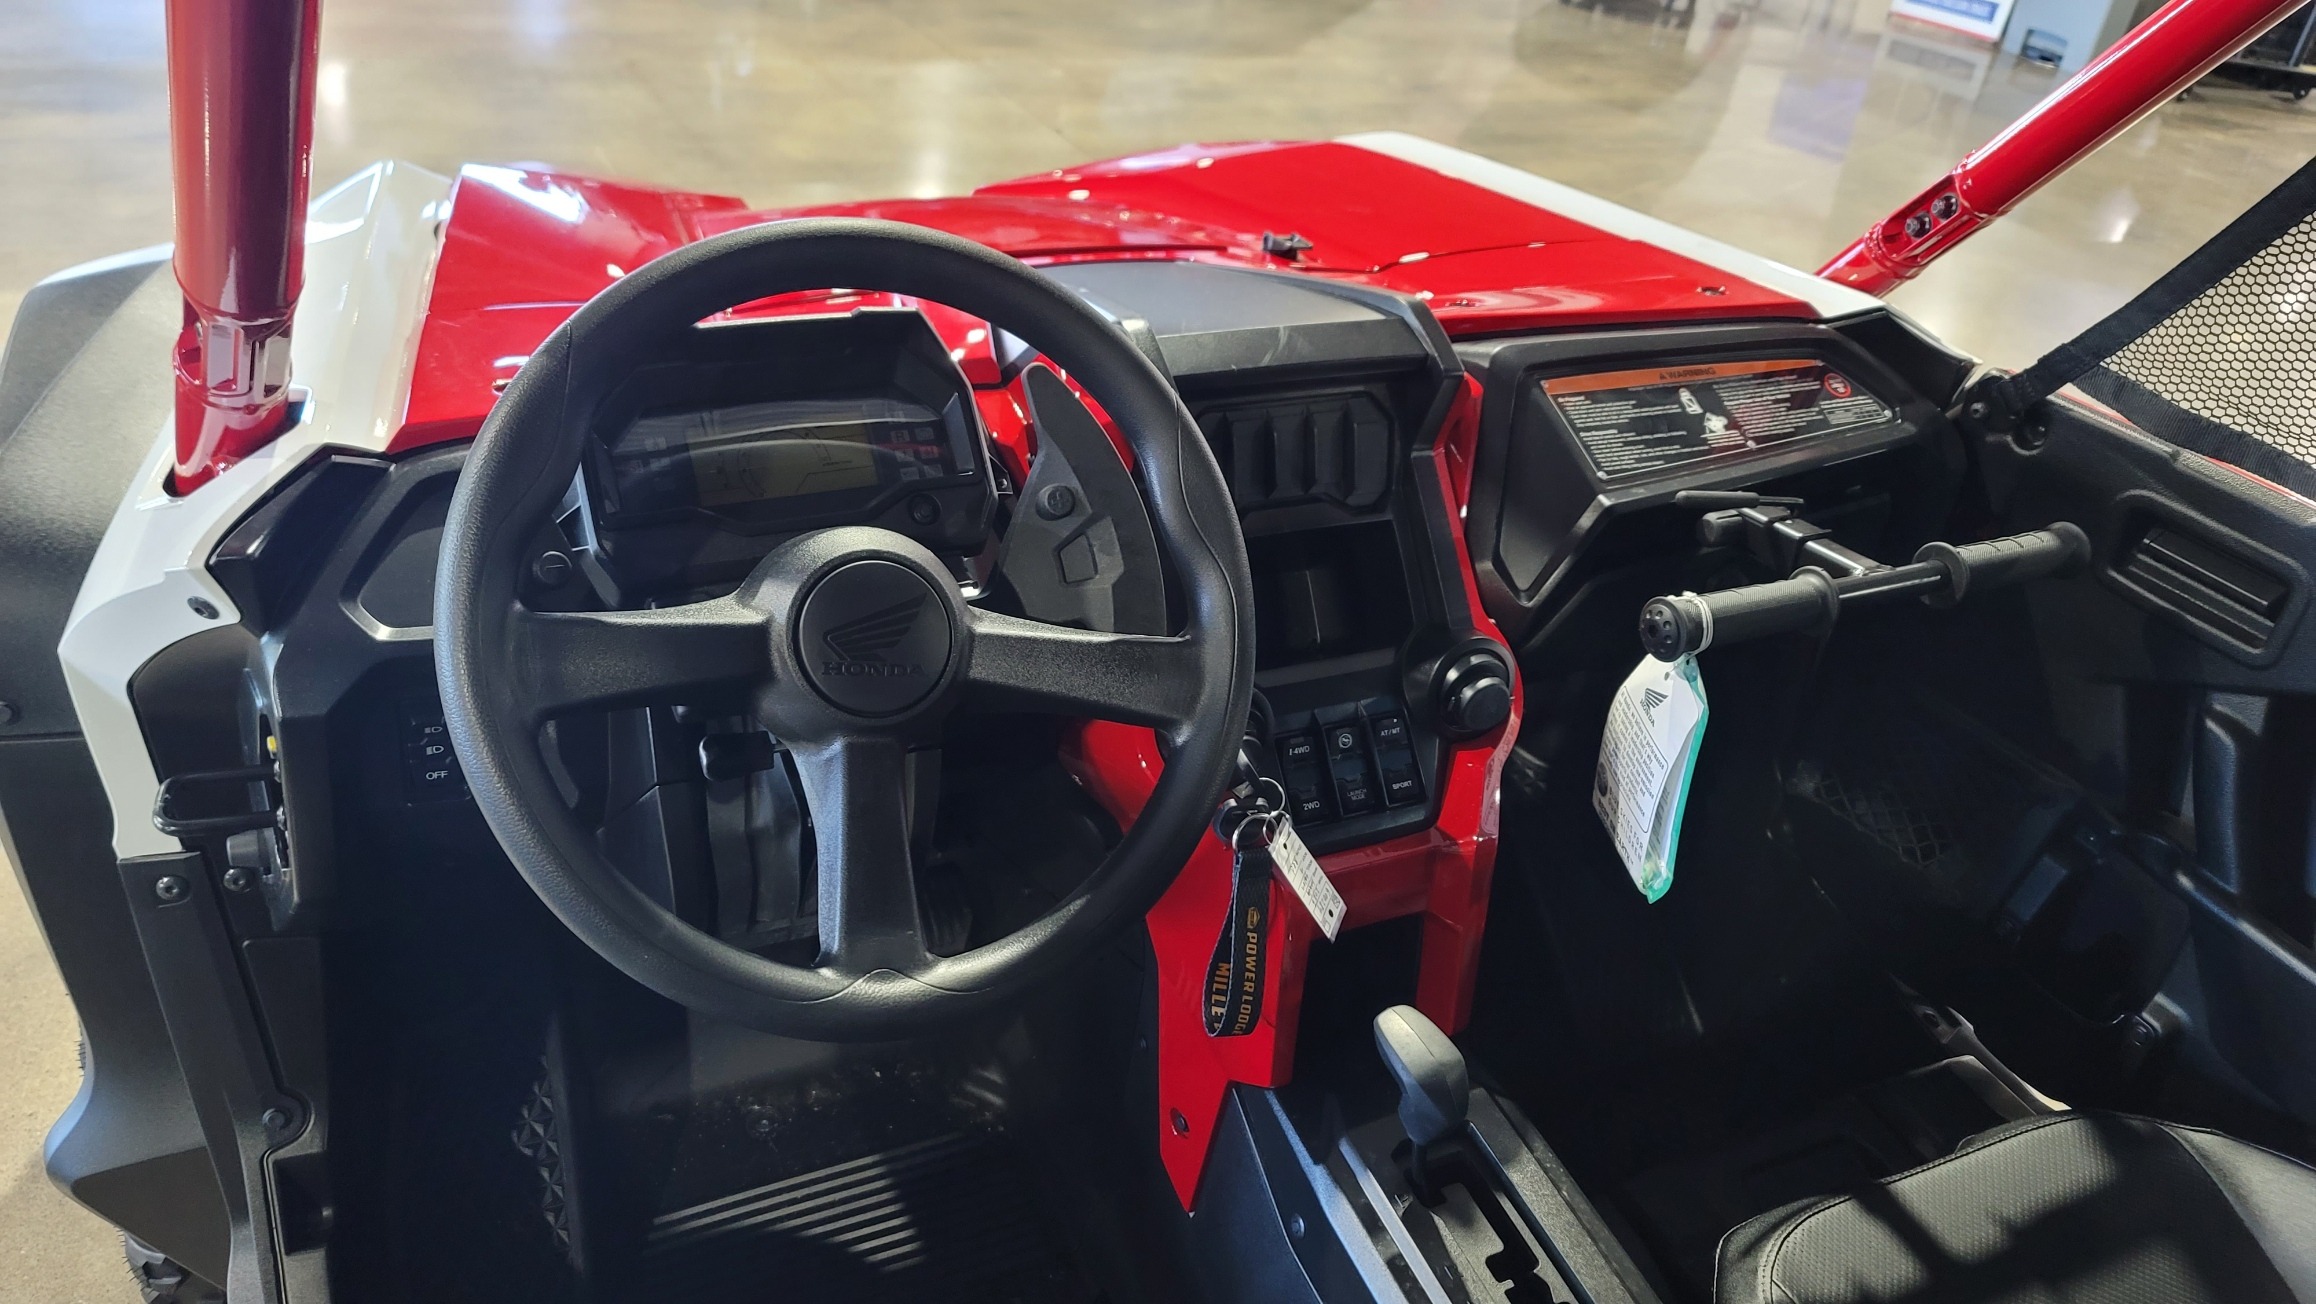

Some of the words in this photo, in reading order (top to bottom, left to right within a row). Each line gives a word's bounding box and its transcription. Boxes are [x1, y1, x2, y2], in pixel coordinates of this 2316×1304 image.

[1668, 367, 1716, 378] WARNING
[822, 661, 925, 677] HONDA
[1640, 698, 1655, 728] HONDA
[425, 770, 448, 780] OFF
[1392, 780, 1413, 790] SPORT
[1303, 801, 1320, 811] 2WD
[1243, 931, 1258, 993] POWER
[1211, 962, 1231, 1017] MILLE
